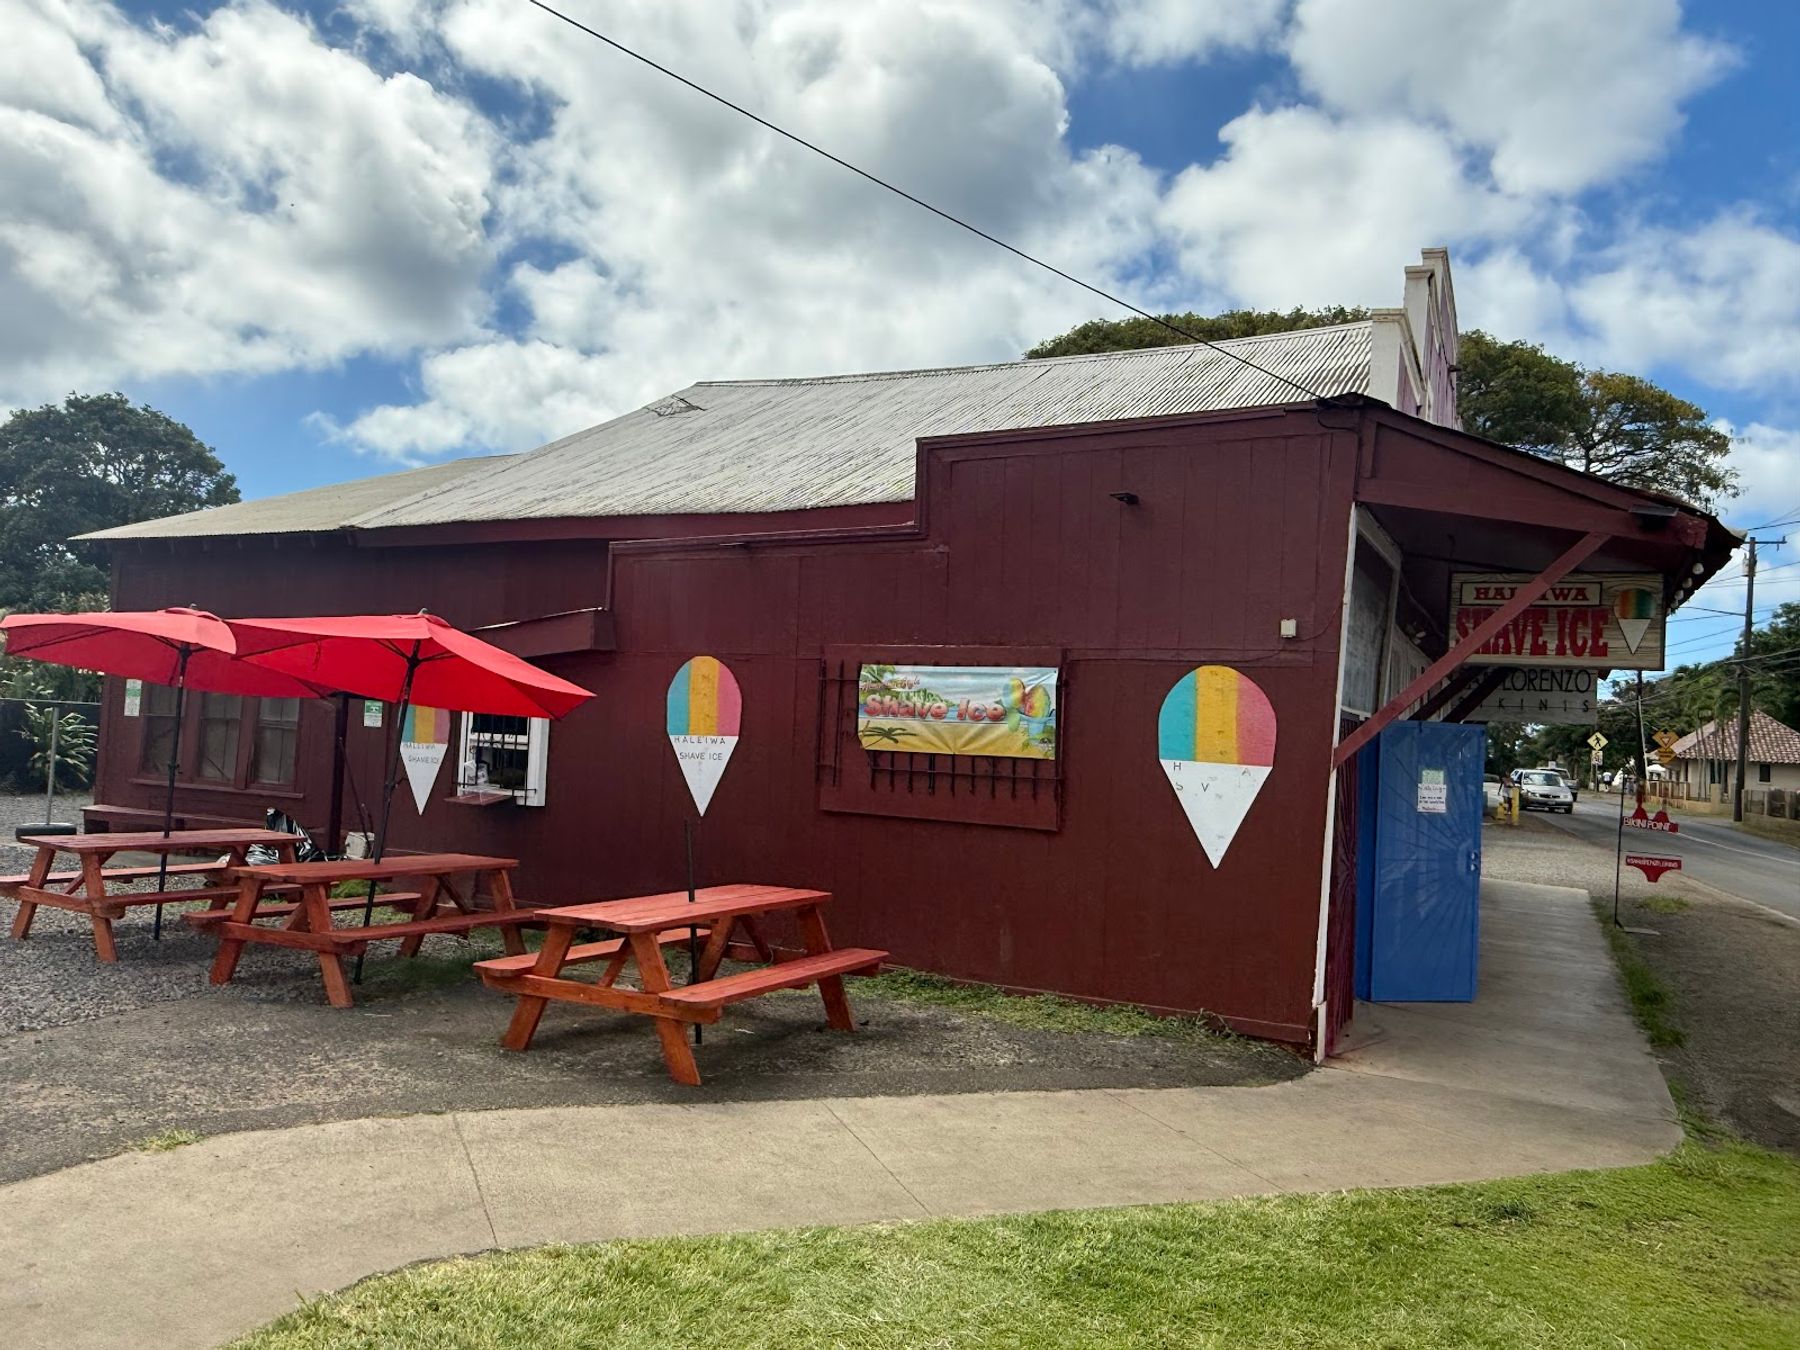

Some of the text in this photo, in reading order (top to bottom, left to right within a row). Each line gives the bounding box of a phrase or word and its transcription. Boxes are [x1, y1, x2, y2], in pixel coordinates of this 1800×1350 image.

[1554, 607, 1610, 658] ICE
[1502, 668, 1592, 693] LORENZO
[864, 694, 1007, 722] Shave Ice
[680, 751, 723, 761] SHAVE ICE
[1647, 820, 1671, 831] POINT
